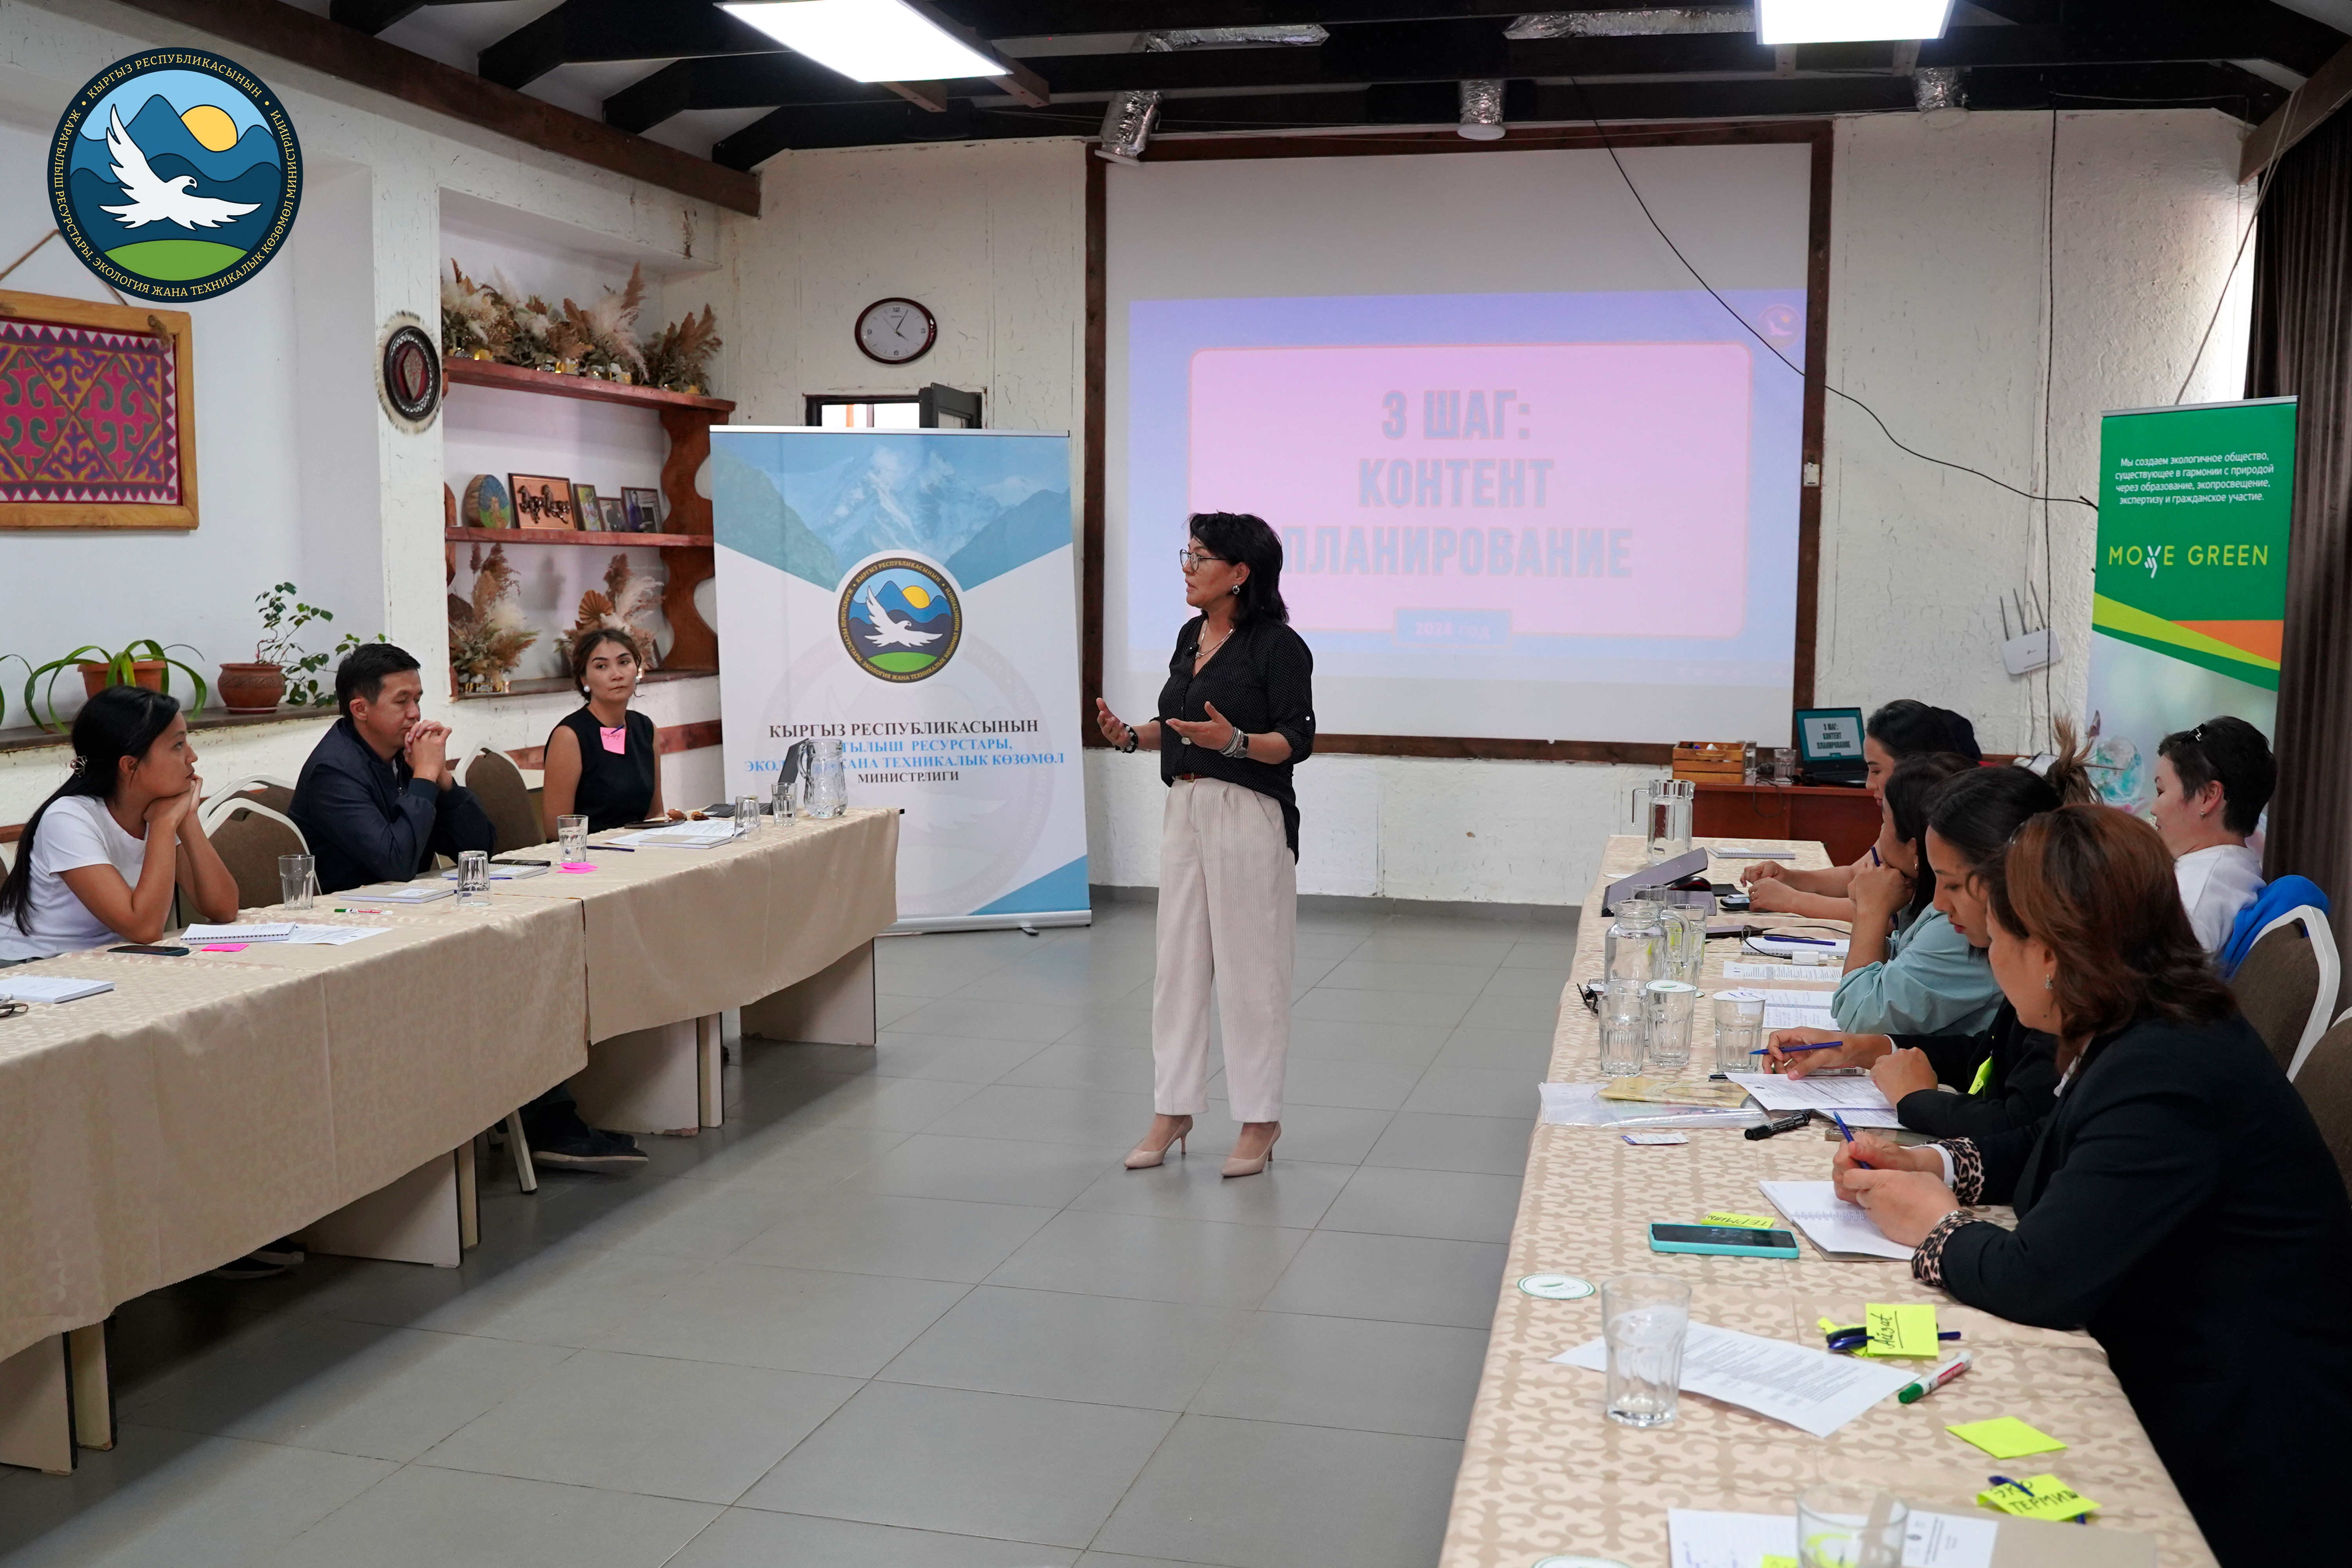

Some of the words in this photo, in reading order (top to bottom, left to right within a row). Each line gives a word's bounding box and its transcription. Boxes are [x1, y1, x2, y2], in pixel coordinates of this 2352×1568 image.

[1423, 389, 1531, 440] ШАГ:
[2121, 458, 2133, 466] Мы
[2135, 457, 2168, 466] создаем
[2170, 454, 2222, 465] экологичное
[2224, 452, 2269, 461] общество,
[2115, 470, 2173, 480] существующее
[2182, 468, 2222, 477] гармонии
[2231, 464, 2274, 475] природой
[1358, 458, 1555, 508] КОНТЕНТ
[2116, 484, 2138, 493] через
[2141, 481, 2195, 491] образование,
[2197, 479, 2270, 490] экопросвещение,
[2120, 495, 2163, 505] экспертизу
[2172, 494, 2226, 504] гражданское
[2229, 493, 2264, 503] участие.
[1280, 525, 1632, 578] ПЛАНИРОВАНИЕ
[2188, 545, 2268, 566] GREEN
[855, 565, 878, 583] КЫРГЫЗ
[878, 560, 941, 582] РЕСПУБЛИКАСЫНЫН
[1414, 622, 1452, 636] 2024
[769, 724, 845, 738] КЫРГЫЗ
[851, 720, 1038, 736] РЕСПУБЛИКАСЫНЫН
[912, 739, 1013, 751] РЕСУРСТАРЫ,
[882, 755, 988, 769] ТЕХНИКАЛЫК
[993, 753, 1064, 765] КӨЗӨМӨЛ
[858, 771, 959, 783] МИНИСТРЛИГИ
